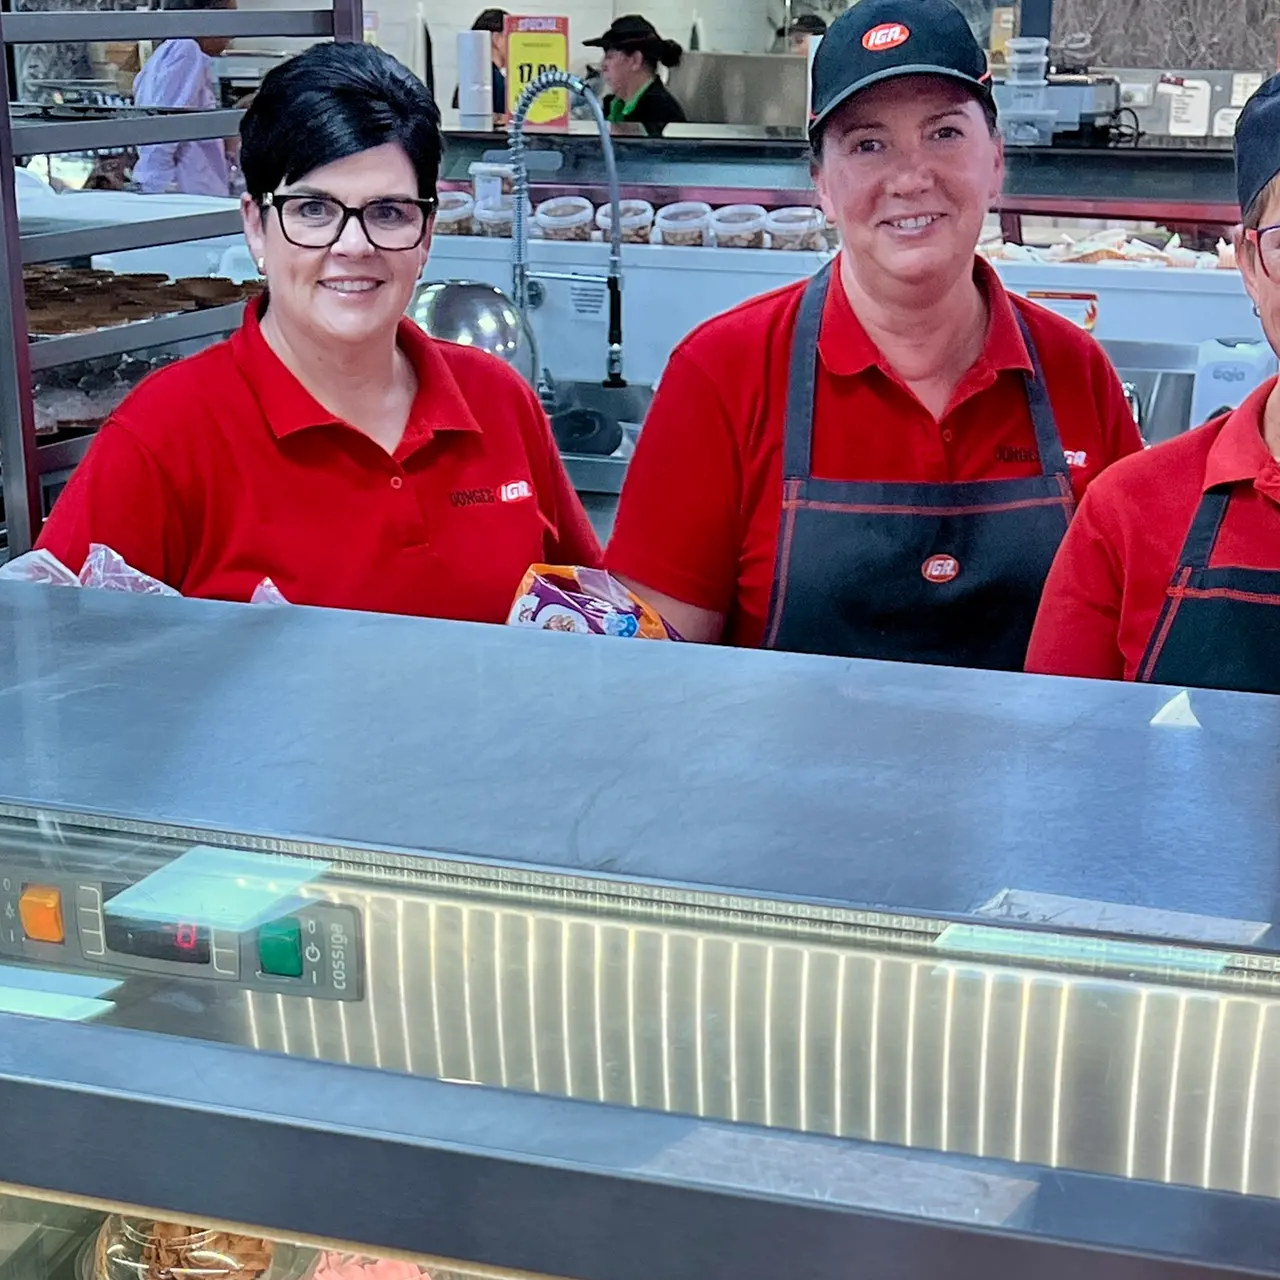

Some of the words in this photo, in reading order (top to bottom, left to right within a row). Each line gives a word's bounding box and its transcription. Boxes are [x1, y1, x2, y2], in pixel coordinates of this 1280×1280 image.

[868, 27, 901, 47] IGA
[1064, 451, 1088, 468] GA
[927, 560, 957, 576] IGA
[329, 922, 347, 991] cossiga
